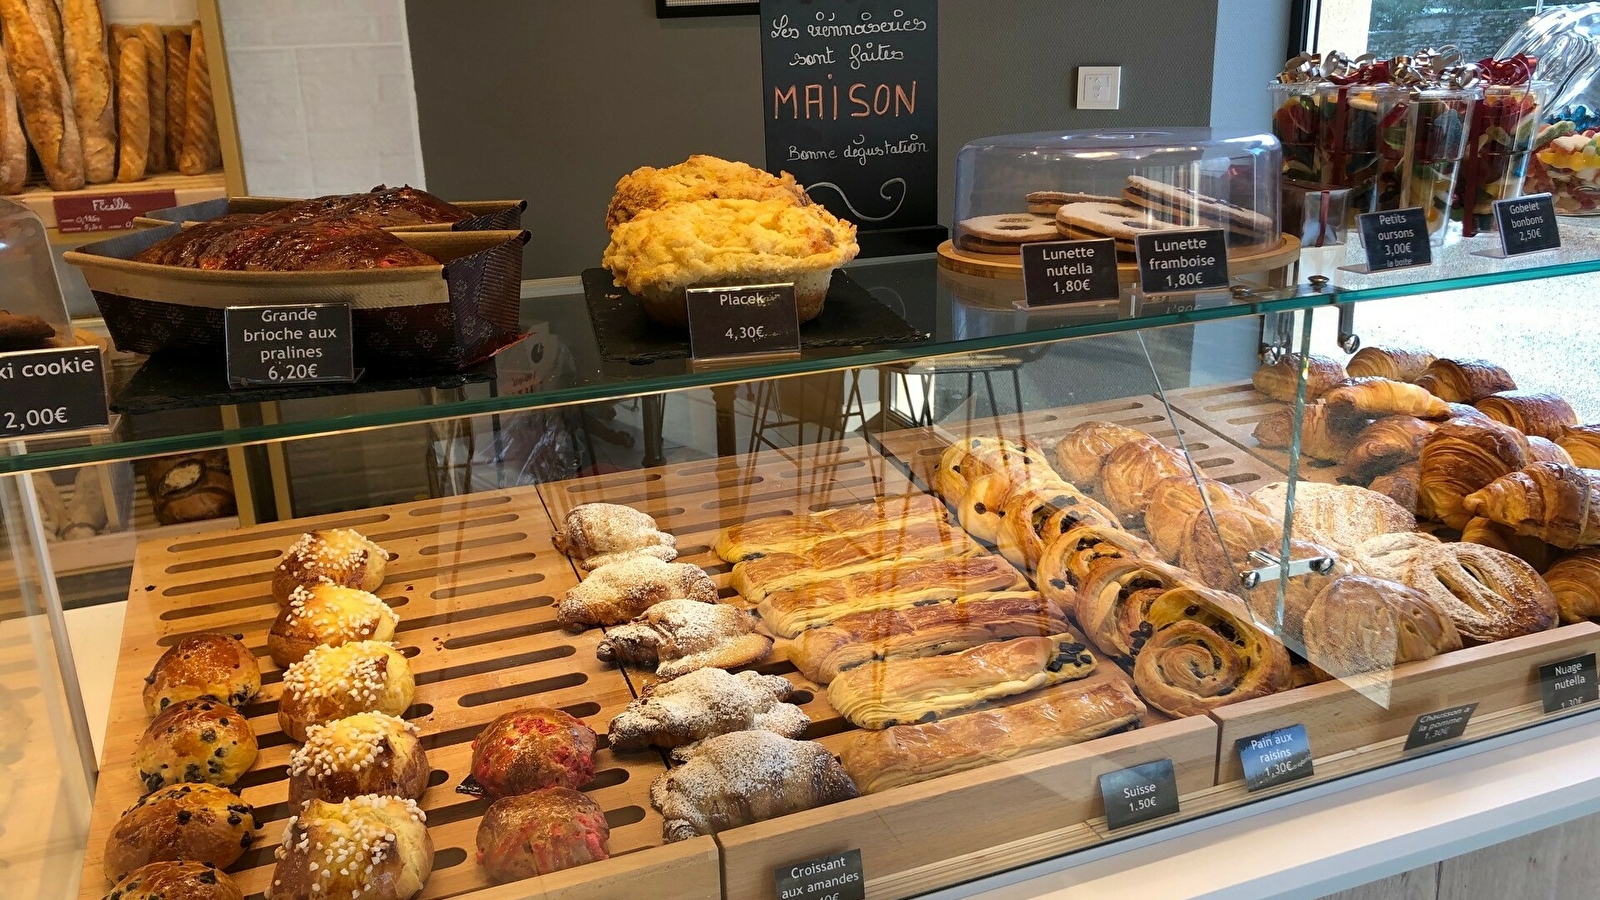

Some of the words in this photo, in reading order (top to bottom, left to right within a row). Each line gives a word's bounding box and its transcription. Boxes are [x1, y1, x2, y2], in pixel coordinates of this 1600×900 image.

[771, 14, 800, 39] Les
[789, 47, 835, 66] sont
[849, 42, 904, 70] faites
[787, 145, 837, 161] Bonne
[844, 134, 928, 166] dégustation
[1509, 202, 1540, 215] Gobelet
[1379, 214, 1407, 226] Petits
[1511, 214, 1544, 228] bonbons
[1378, 229, 1414, 241] oursons
[1519, 228, 1542, 242] 2,50€
[1154, 238, 1207, 252] Lunette
[1385, 242, 1412, 256] 3,00€
[1042, 247, 1095, 261] Lunette
[1046, 262, 1093, 277] nutella
[1149, 255, 1216, 271] framboise
[1052, 279, 1091, 295] 1,80€
[1166, 272, 1203, 289] 1,80€
[720, 292, 765, 306] Placek
[261, 308, 317, 322] Grande
[243, 327, 303, 342] brioche
[308, 328, 337, 339] aux
[725, 326, 764, 341] 4,30€
[260, 346, 323, 363] pralines
[22, 356, 95, 378] cookie
[268, 363, 318, 383] 6,20€
[4, 407, 68, 431] 2,00€
[1555, 662, 1582, 676] Nuage
[1554, 675, 1586, 690] nutella
[1428, 717, 1462, 732] pomme
[1250, 737, 1273, 750] Pain
[1274, 733, 1293, 745] aux
[1260, 748, 1292, 763] raisins
[1123, 783, 1156, 799] Suisse
[1129, 796, 1157, 812] 1.50€
[791, 856, 846, 879] Croissant
[781, 886, 804, 900] aux
[807, 872, 859, 893] amandes
